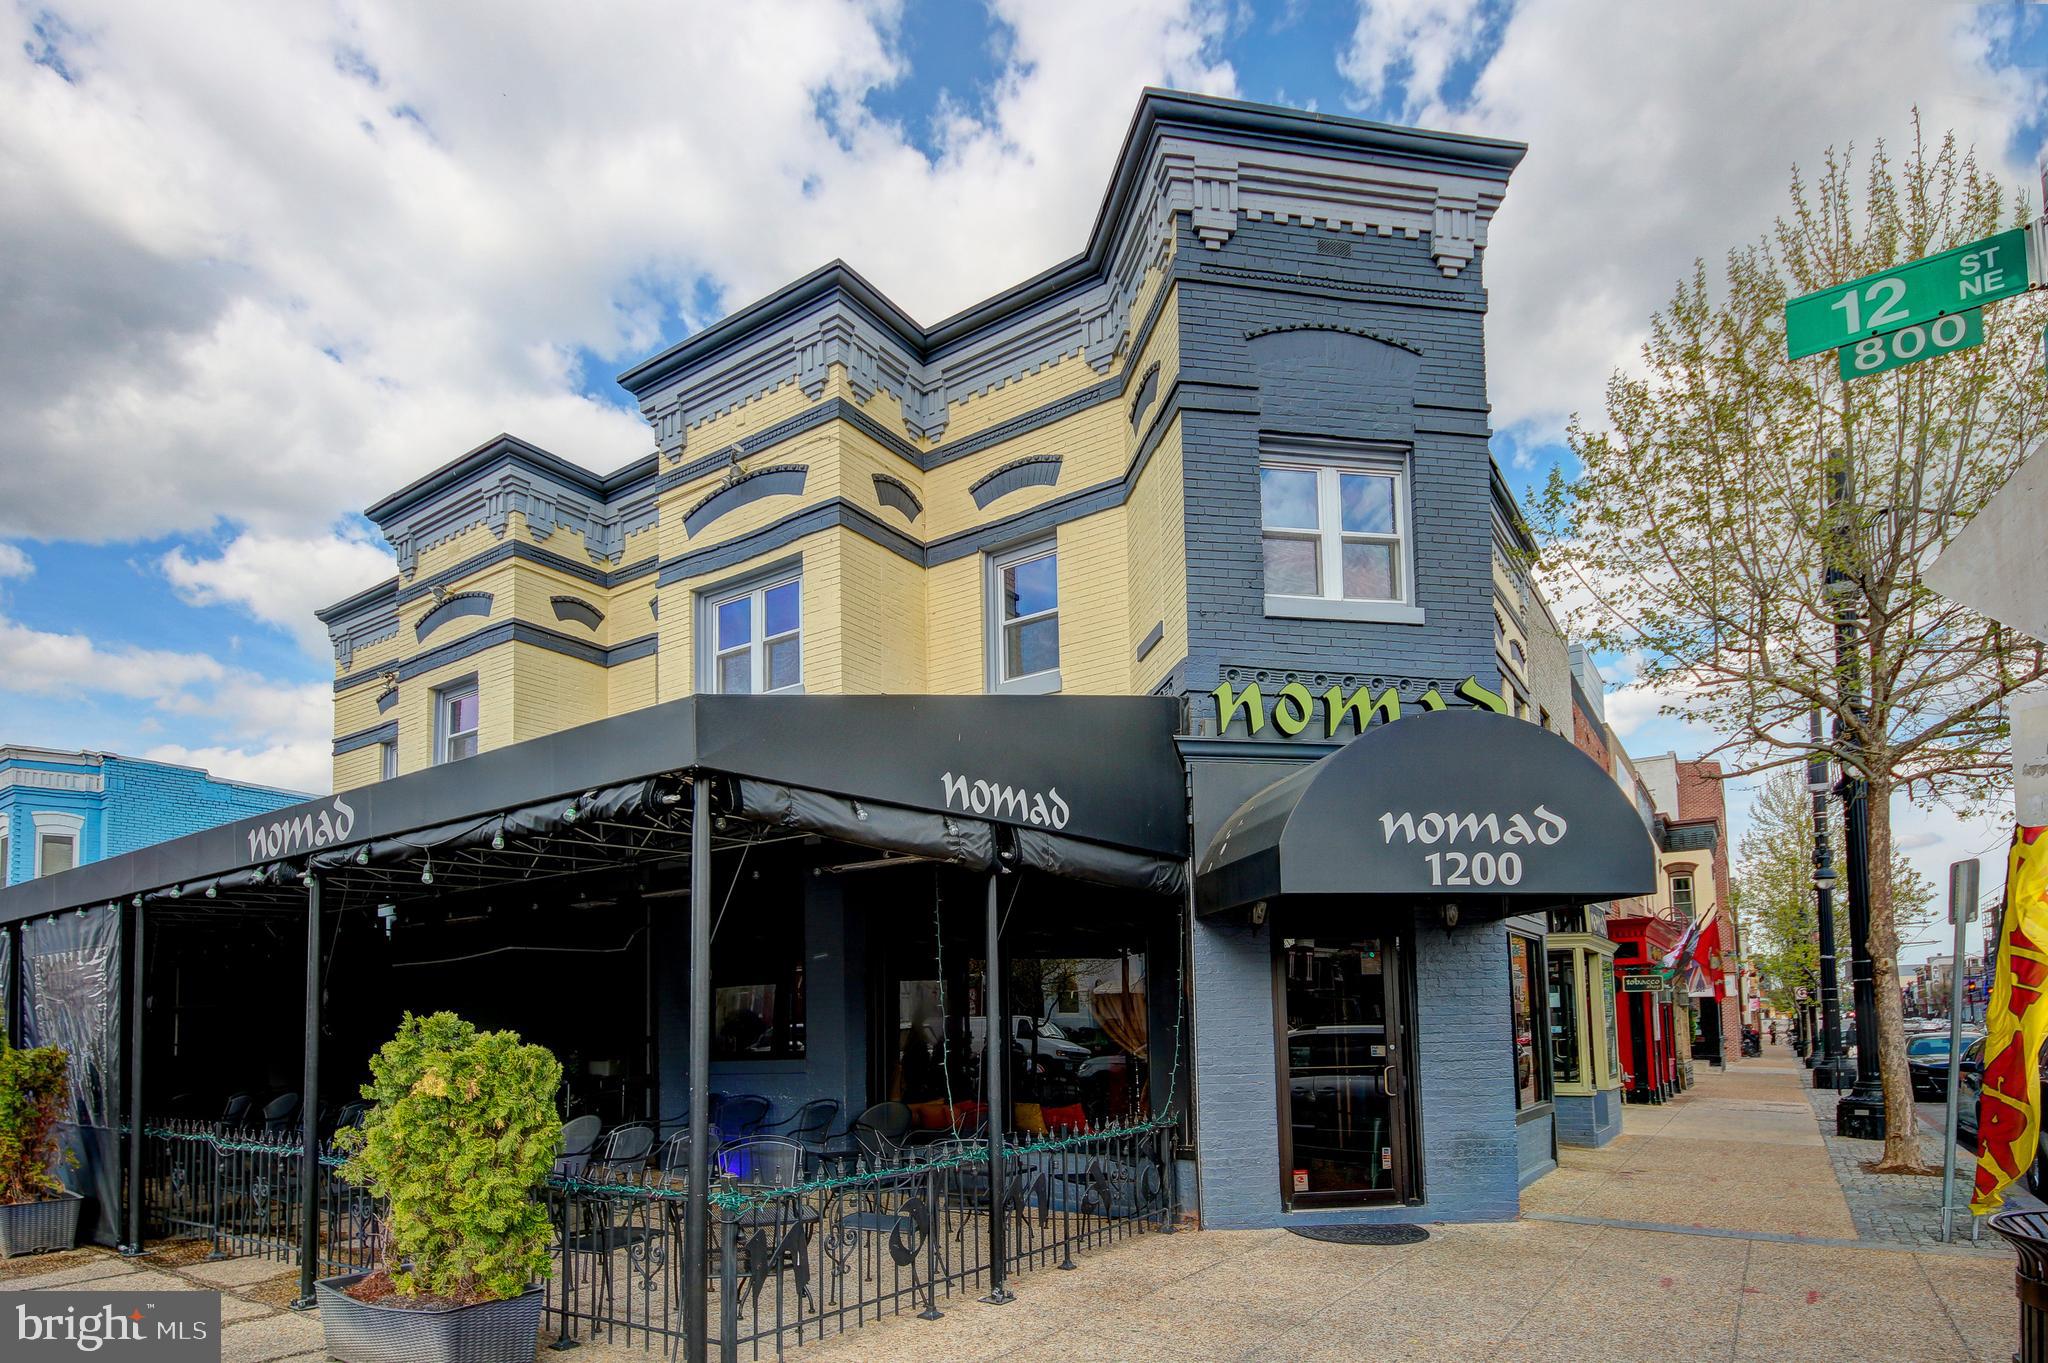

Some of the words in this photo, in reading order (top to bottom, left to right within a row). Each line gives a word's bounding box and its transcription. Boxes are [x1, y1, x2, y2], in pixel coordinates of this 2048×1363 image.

[1958, 246, 2000, 276] ST
[1958, 268, 2006, 300] NE
[1831, 277, 1910, 335] 12
[1854, 313, 1967, 371] 800
[940, 771, 1070, 830] nomad
[247, 794, 355, 862] nomad
[1378, 804, 1568, 845] nomad
[1424, 851, 1523, 886] 1200
[1626, 978, 1660, 986] tobacco
